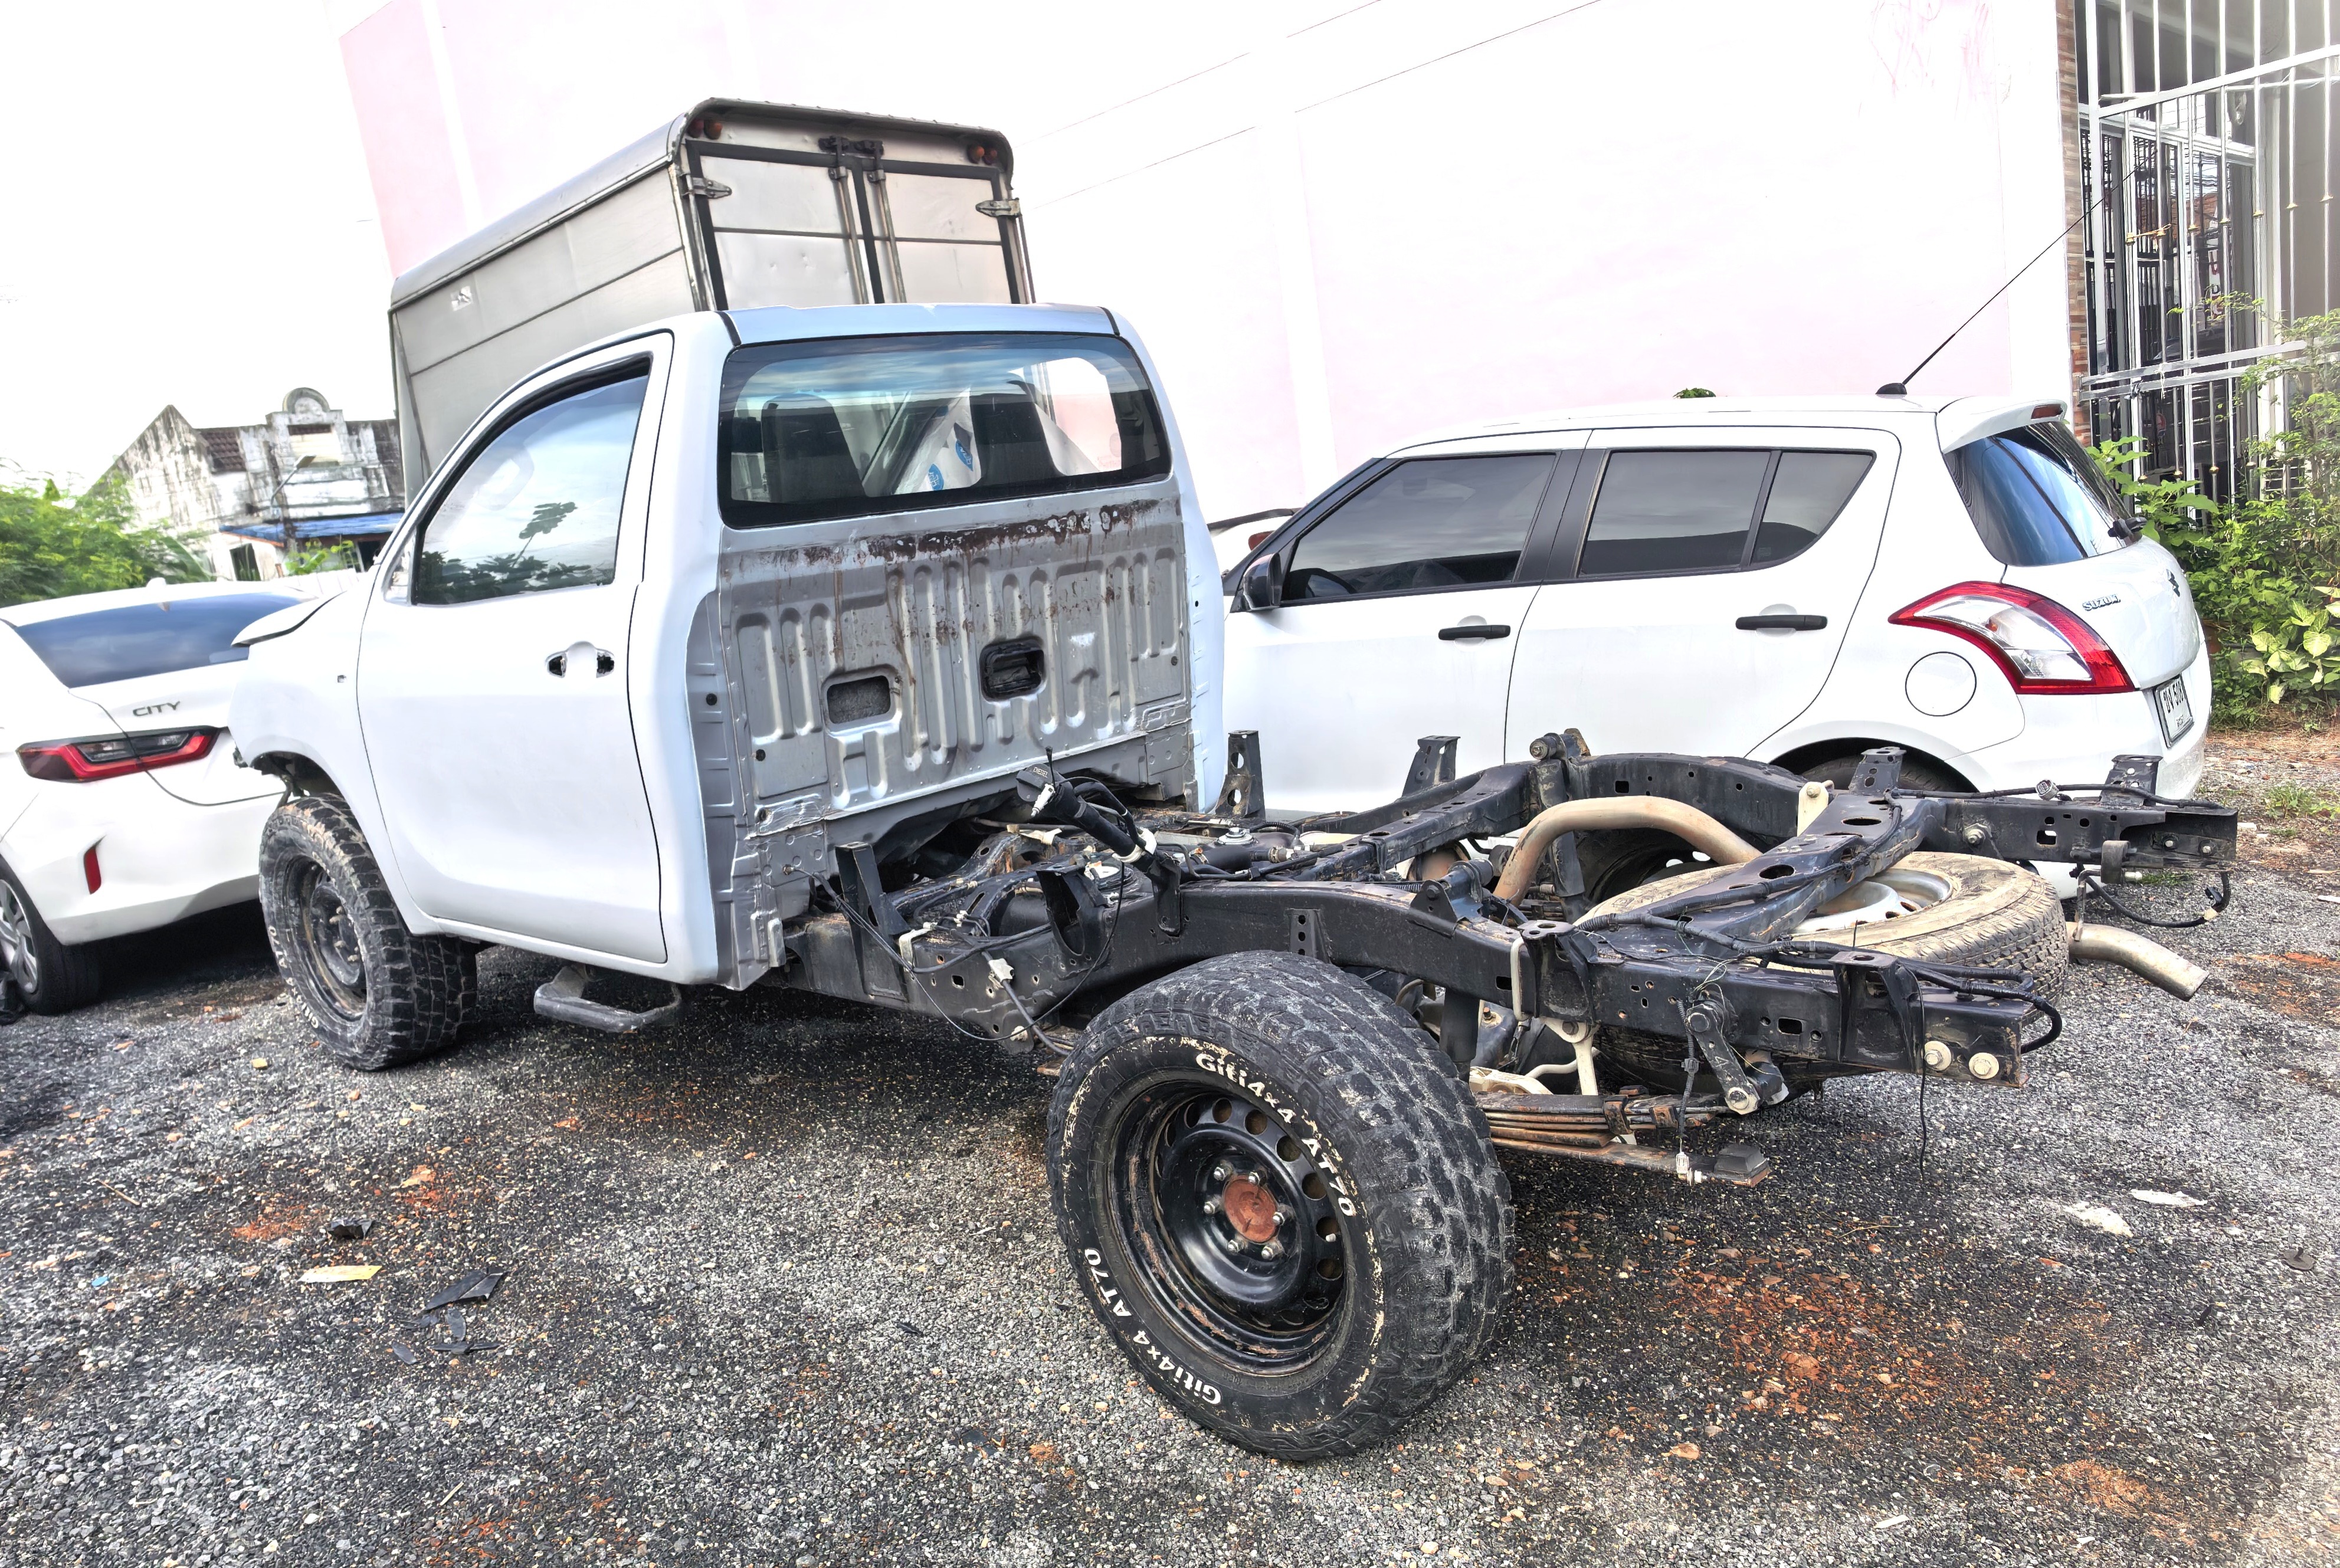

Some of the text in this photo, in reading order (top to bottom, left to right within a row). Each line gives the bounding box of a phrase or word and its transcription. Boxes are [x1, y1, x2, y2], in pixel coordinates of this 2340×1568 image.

[2082, 594, 2121, 611] SUZUKI
[133, 701, 180, 716] CITY
[1033, 766, 1048, 778] DIESEL
[1196, 1053, 1356, 1216] Giti4x4 AT70
[1084, 1249, 1221, 1405] Giti4x4 AT70
